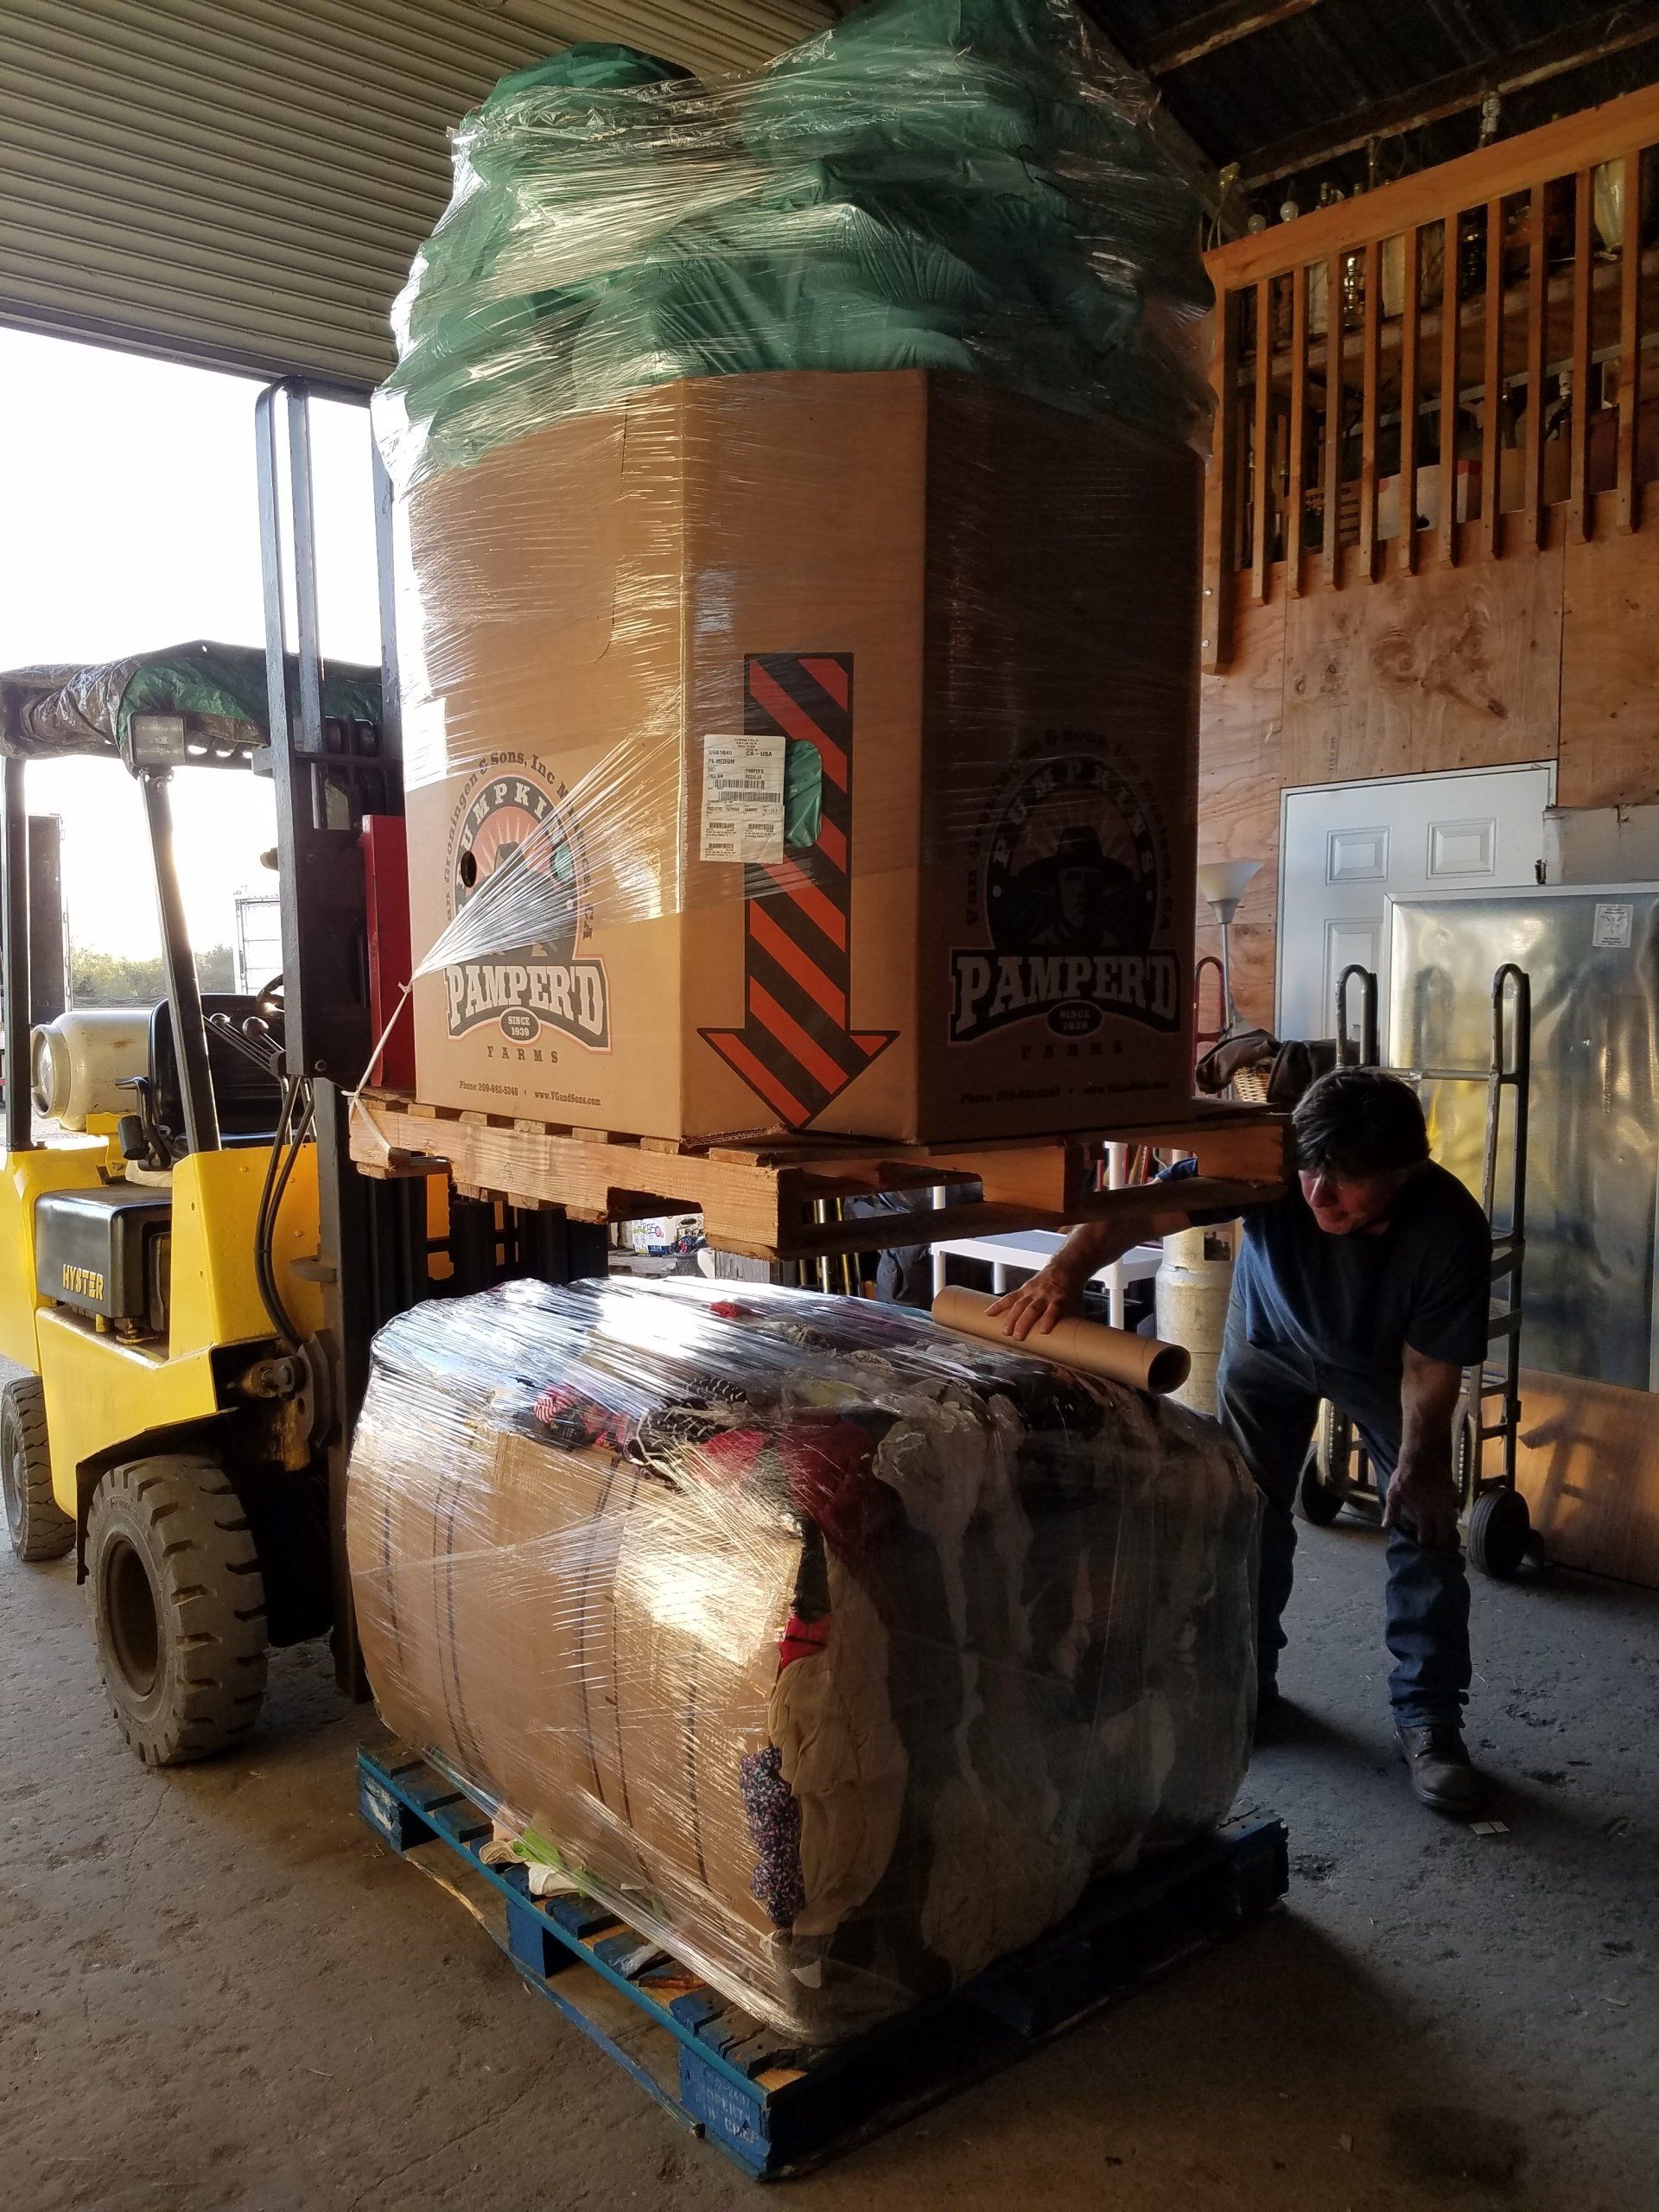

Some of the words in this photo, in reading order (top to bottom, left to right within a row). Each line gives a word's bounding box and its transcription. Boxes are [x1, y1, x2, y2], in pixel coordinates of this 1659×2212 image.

[447, 965, 604, 1036] PAMPER'D
[508, 1015, 531, 1026] SINCE
[512, 1027, 530, 1036] 1939
[486, 1046, 559, 1064] FARMS
[62, 1263, 105, 1301] HYSTER
